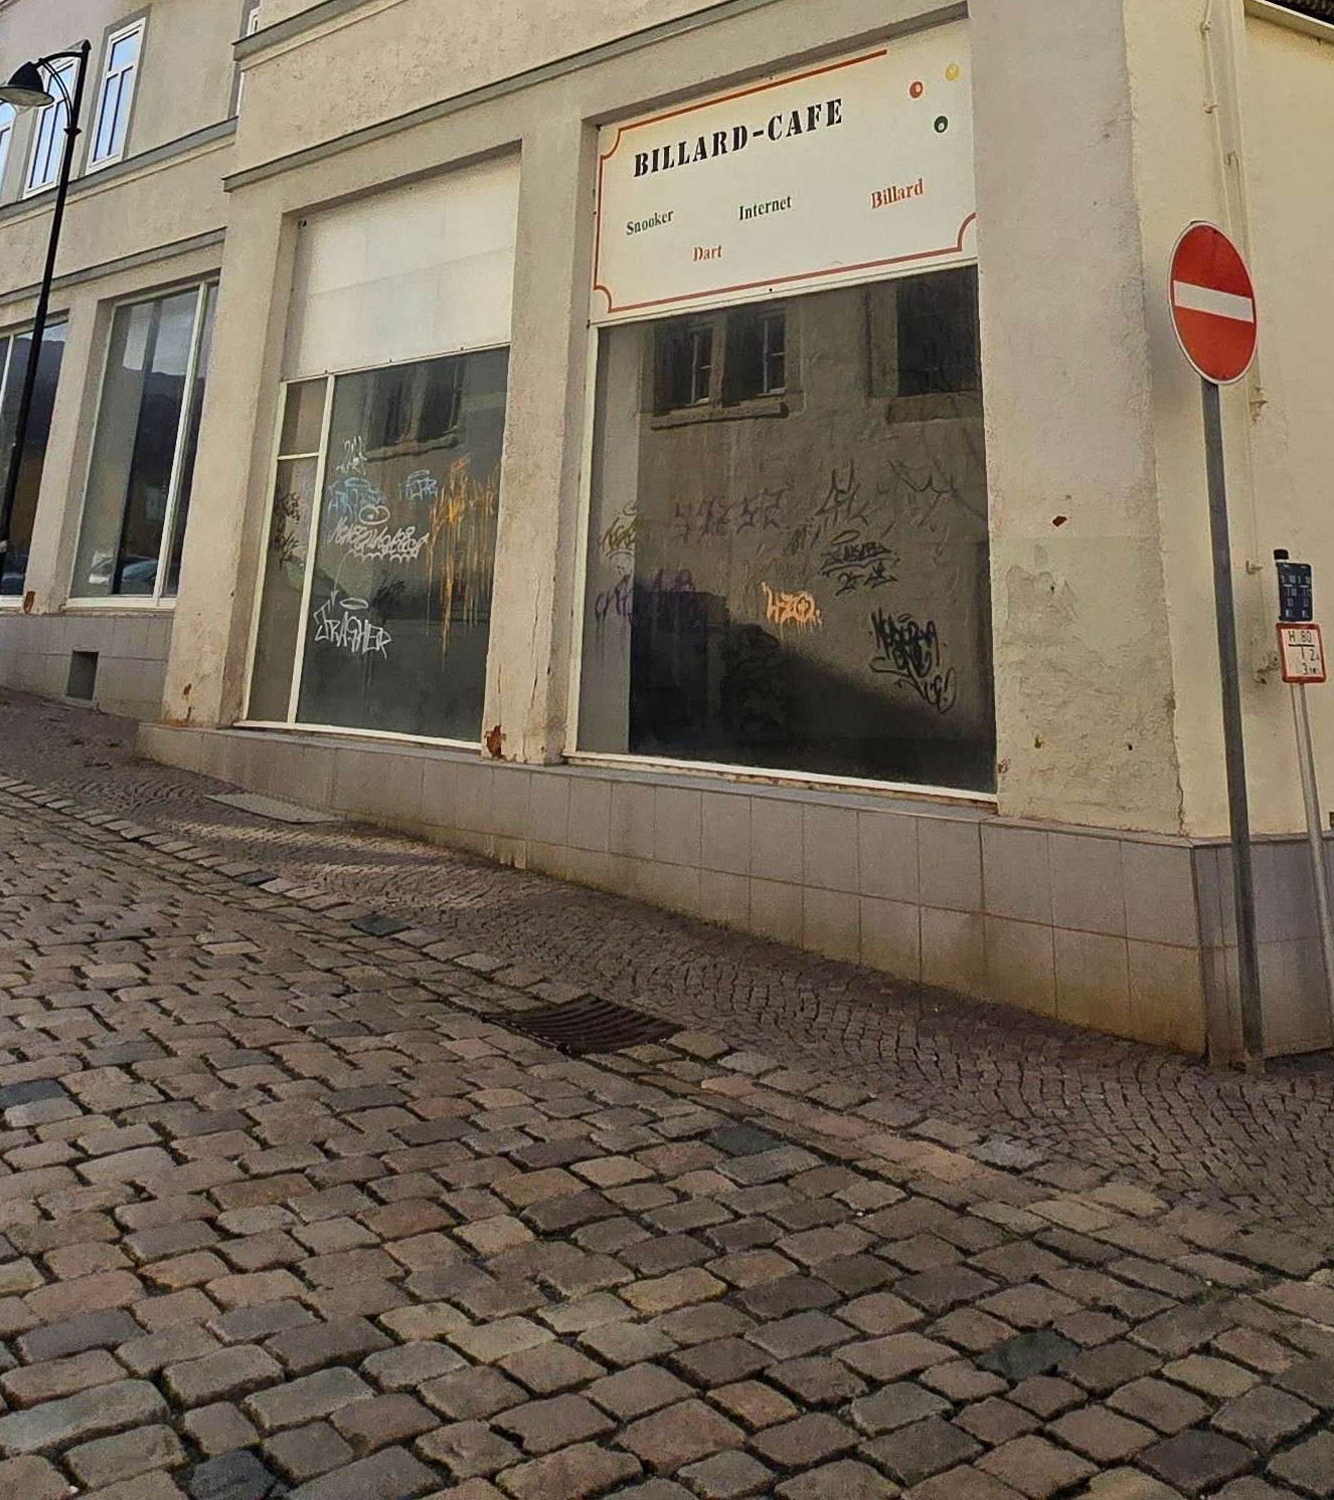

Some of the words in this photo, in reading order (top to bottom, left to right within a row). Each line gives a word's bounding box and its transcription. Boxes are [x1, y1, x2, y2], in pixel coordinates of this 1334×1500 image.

[634, 98, 844, 178] BILLARD-CAFE
[626, 209, 674, 236] Snooker
[738, 195, 792, 221] Internet
[870, 178, 924, 209] Billard
[693, 245, 723, 262] Dart
[1288, 630, 1296, 642] H
